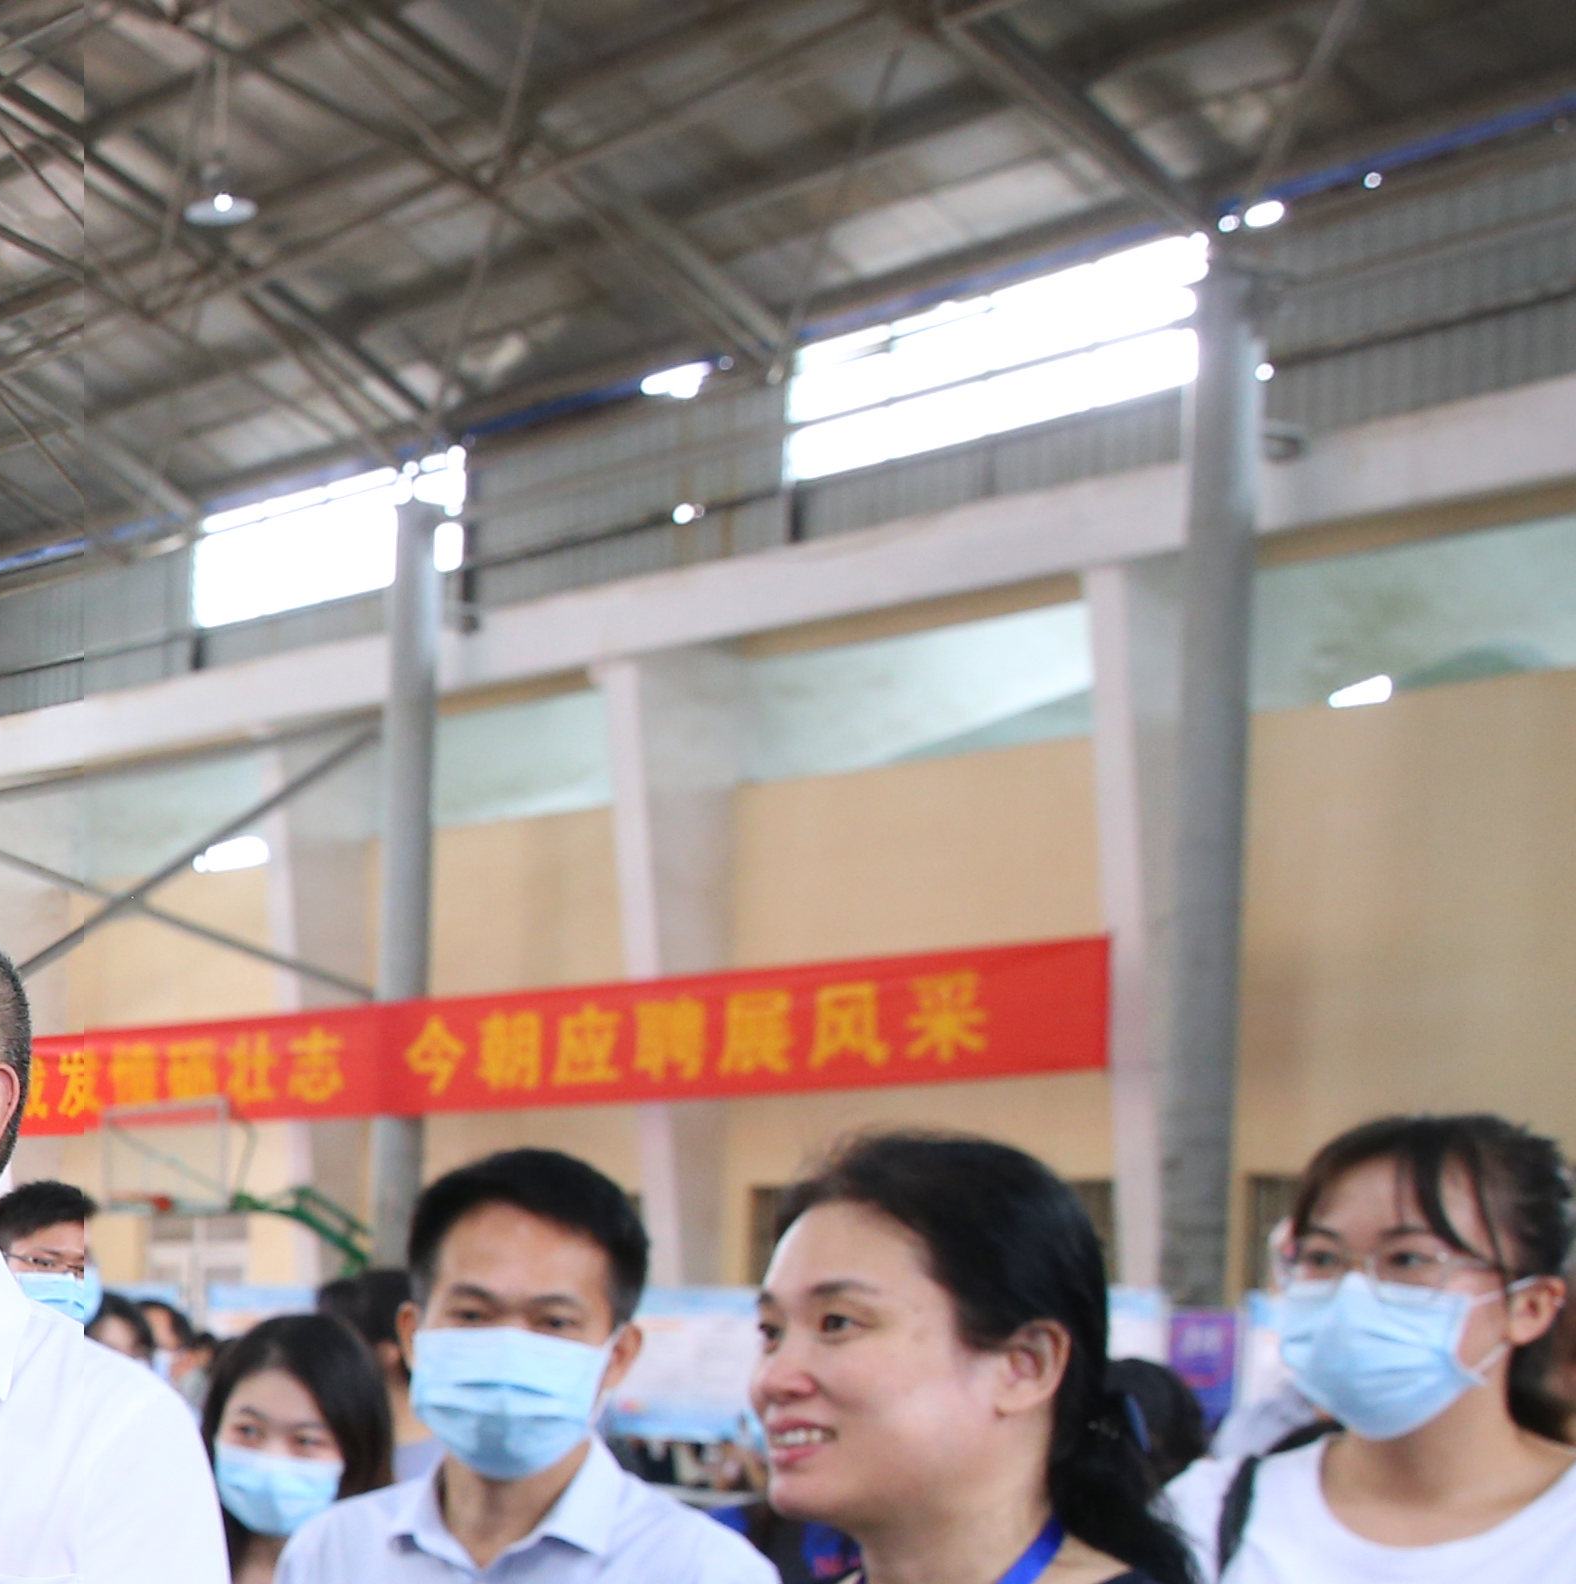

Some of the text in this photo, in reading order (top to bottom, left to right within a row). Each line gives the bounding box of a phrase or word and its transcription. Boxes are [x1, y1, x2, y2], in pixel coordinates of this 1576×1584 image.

[404, 970, 989, 1090] 今朝应聘展风采
